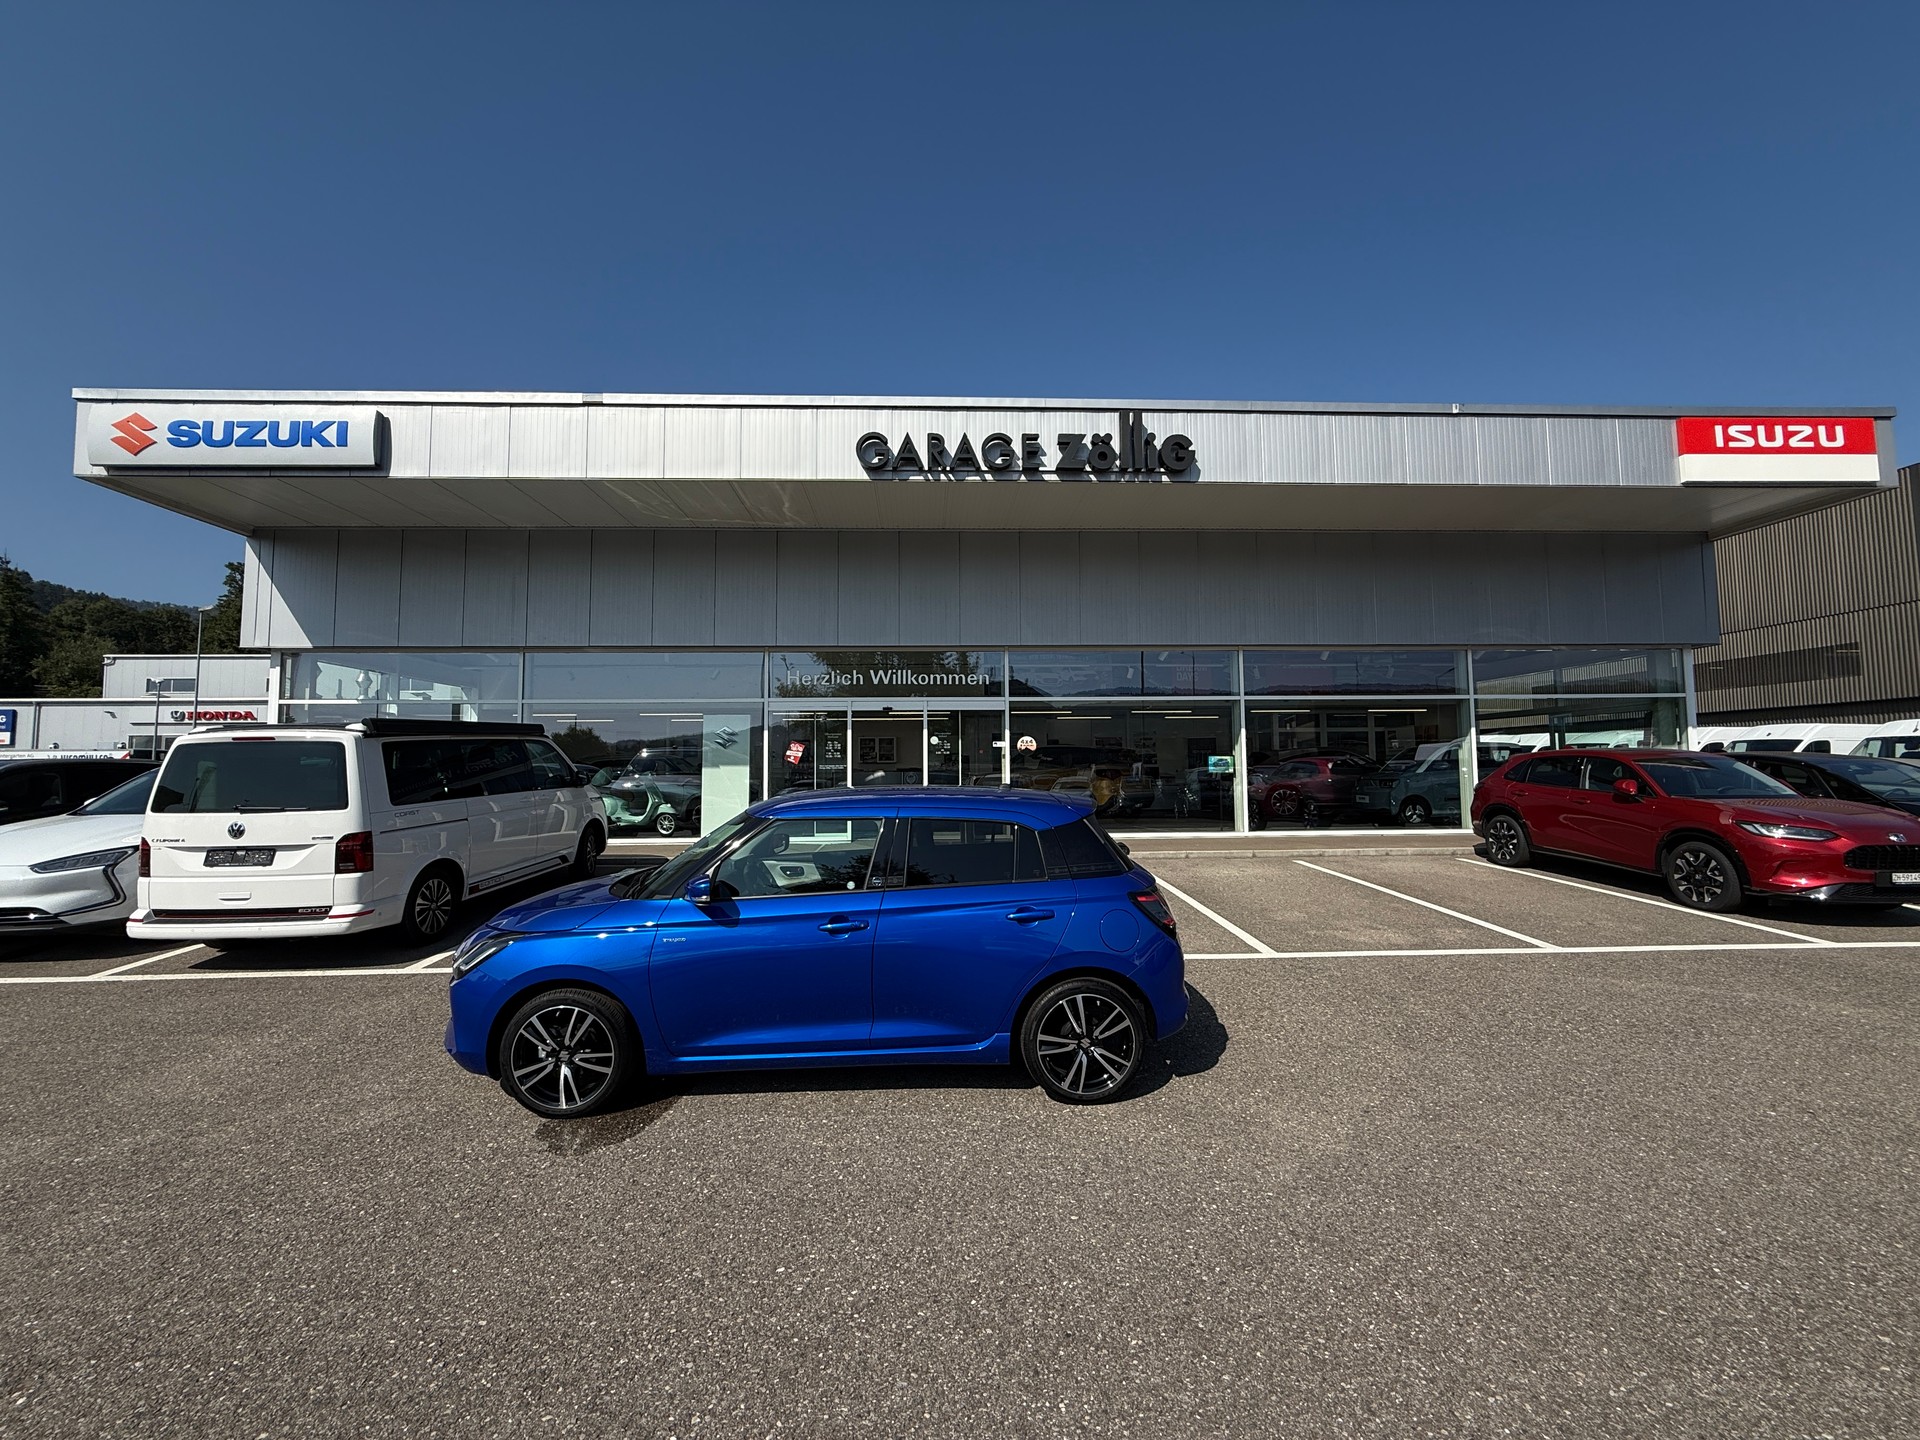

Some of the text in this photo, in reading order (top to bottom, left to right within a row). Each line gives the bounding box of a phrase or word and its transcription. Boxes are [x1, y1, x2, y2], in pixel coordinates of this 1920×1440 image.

[167, 419, 348, 448] SUZUKI
[1714, 424, 1845, 448] ISUZU
[855, 431, 1040, 471] GARAGE
[786, 669, 991, 685] Herzlich Willkommen
[187, 711, 258, 721] HONDA
